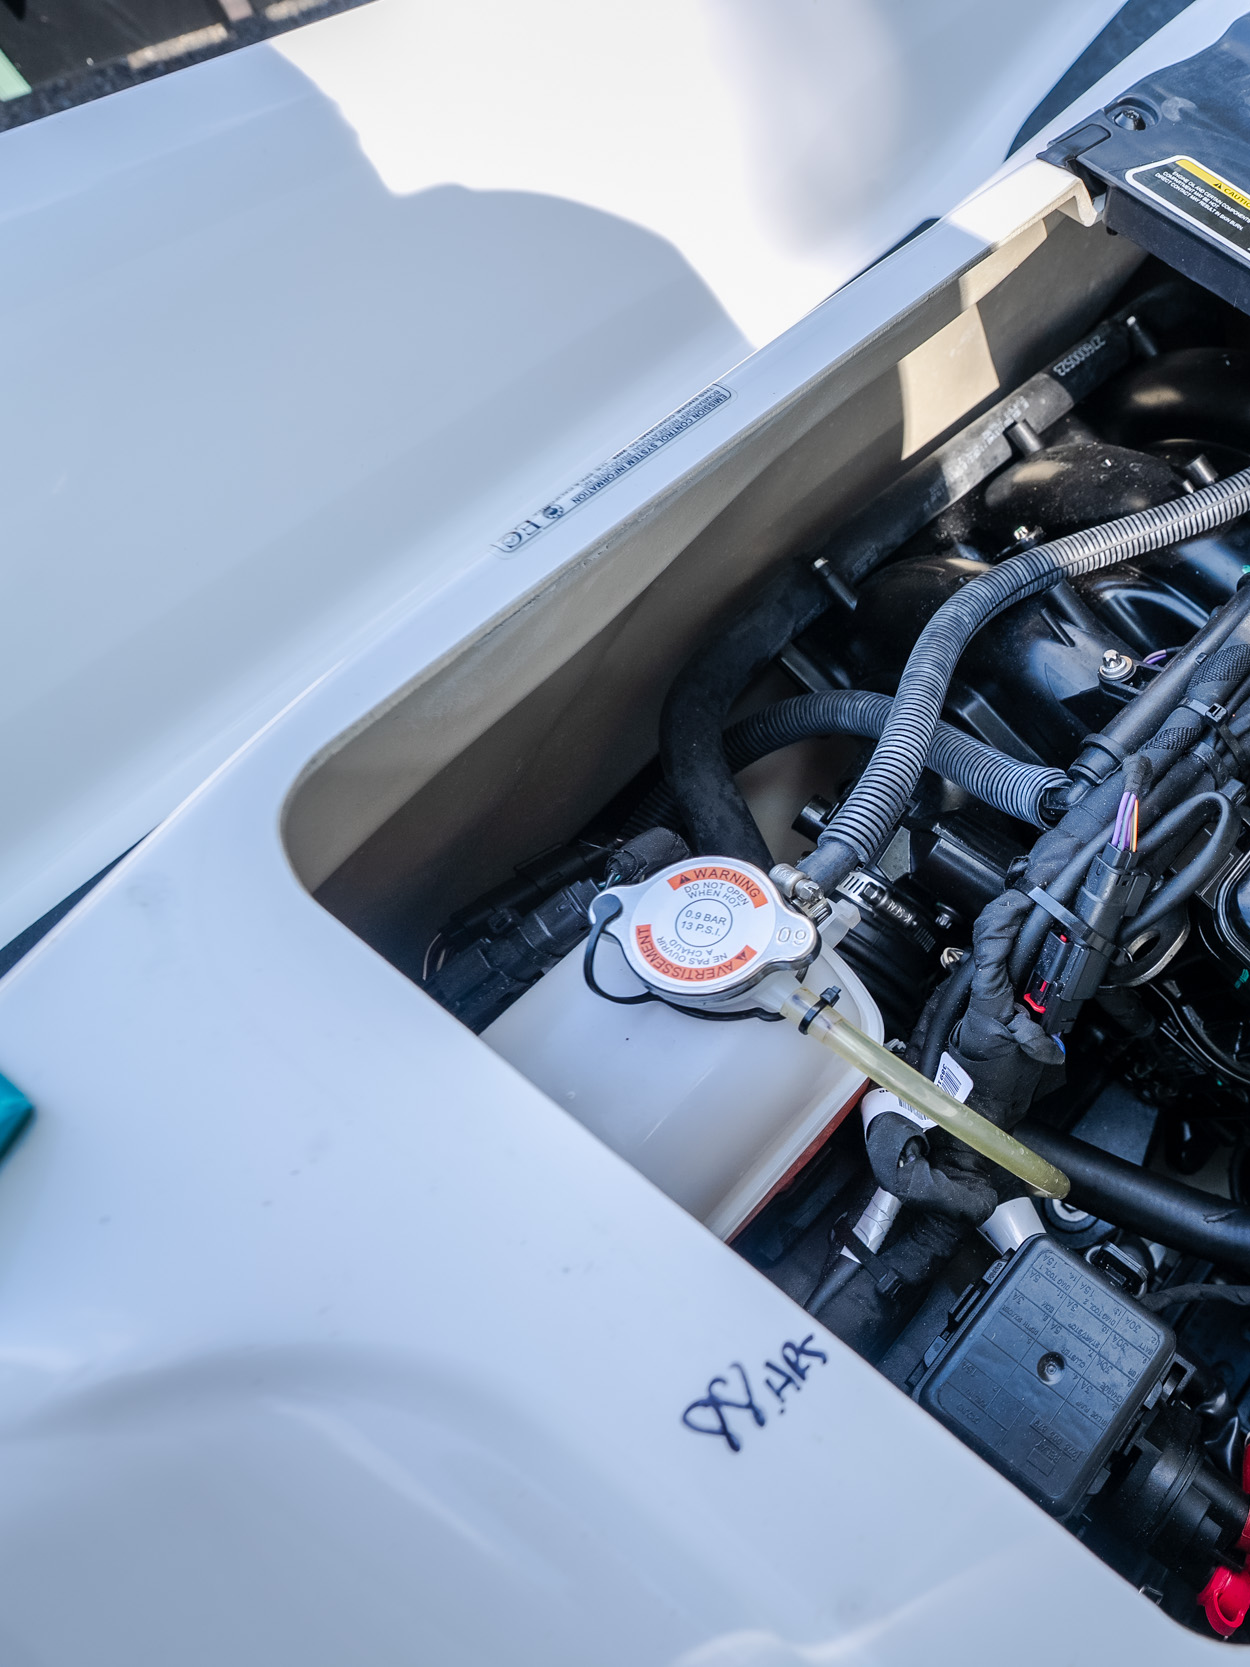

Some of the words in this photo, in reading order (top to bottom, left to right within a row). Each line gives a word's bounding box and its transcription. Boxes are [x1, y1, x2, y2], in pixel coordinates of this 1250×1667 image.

[1162, 170, 1195, 193] COMPARTMENT
[1192, 190, 1203, 198] MAY
[1208, 200, 1220, 209] HOT.
[1171, 170, 1189, 183] ENGINE
[1194, 184, 1205, 193] AND
[1203, 190, 1222, 204] CERTAIN
[1154, 172, 1171, 184] DIRECT
[1169, 182, 1191, 197] CONTACT
[1189, 194, 1200, 203] MAY
[1198, 200, 1216, 213] RESULT
[1218, 213, 1230, 222] SKIN
[1228, 220, 1244, 231] BURN.
[678, 389, 720, 419] BOMBARDIER
[691, 393, 727, 419] EMISSION
[631, 418, 679, 452] RECREATIONAL
[656, 417, 693, 443] CONTROL
[625, 442, 657, 465] SYSTEM
[593, 452, 632, 479] PRODUCTS
[571, 464, 626, 503] INFORMATION
[694, 868, 760, 898] WARNING
[684, 884, 699, 893] DO
[727, 886, 749, 906] OPEN
[688, 889, 720, 898] WHEN
[722, 892, 741, 908] HOT
[681, 921, 693, 930] 13
[695, 924, 720, 936] P.S.I.
[685, 910, 702, 920] 0.9
[704, 914, 727, 926] BAR
[638, 928, 733, 980] AVERTISSEMENT
[669, 940, 702, 957] CHAUD
[712, 953, 728, 963] NE
[688, 958, 710, 966] PAS
[1040, 1253, 1058, 1269] 15A
[1042, 1267, 1058, 1280] TOOL
[1056, 1278, 1070, 1290] DIAG
[1077, 1281, 1095, 1297] 15A
[1087, 1302, 1103, 1316] TOOL
[1101, 1312, 1116, 1326] DIAG
[1067, 1320, 1100, 1349] START/STOP
[1122, 1316, 1141, 1334] 30A
[1060, 1346, 1086, 1368] CLUSTER
[1137, 1341, 1153, 1356] BATT
[1099, 1381, 1123, 1402] CHARGE
[1034, 1438, 1061, 1464] RELAY
